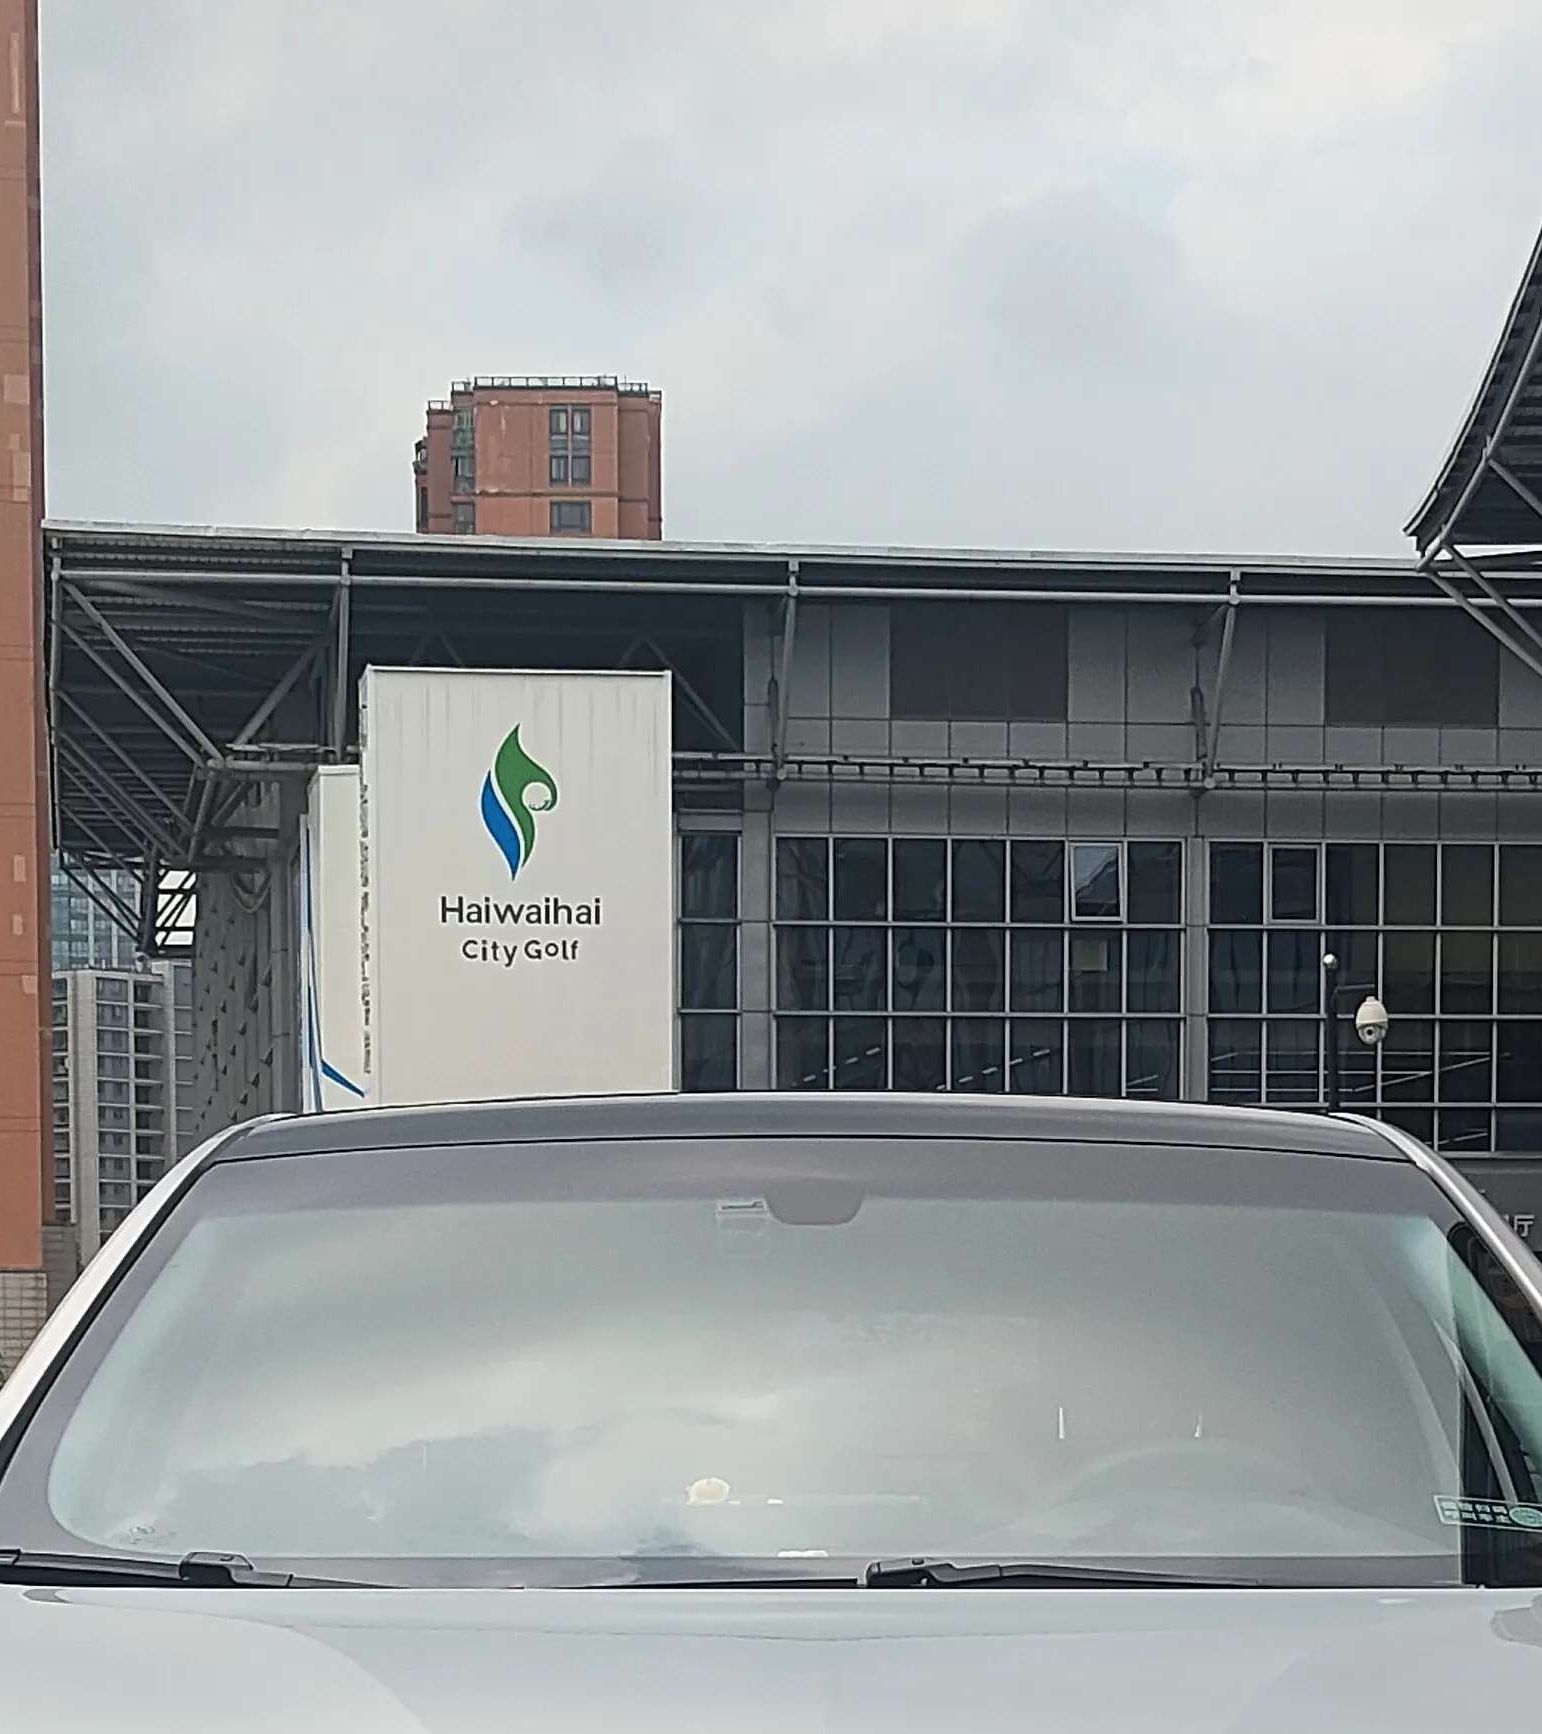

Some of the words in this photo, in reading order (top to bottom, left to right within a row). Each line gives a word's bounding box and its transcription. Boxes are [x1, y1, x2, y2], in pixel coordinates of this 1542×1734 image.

[439, 896, 602, 926] Haiwaihai
[461, 939, 519, 967] City
[523, 938, 579, 960] Golf
